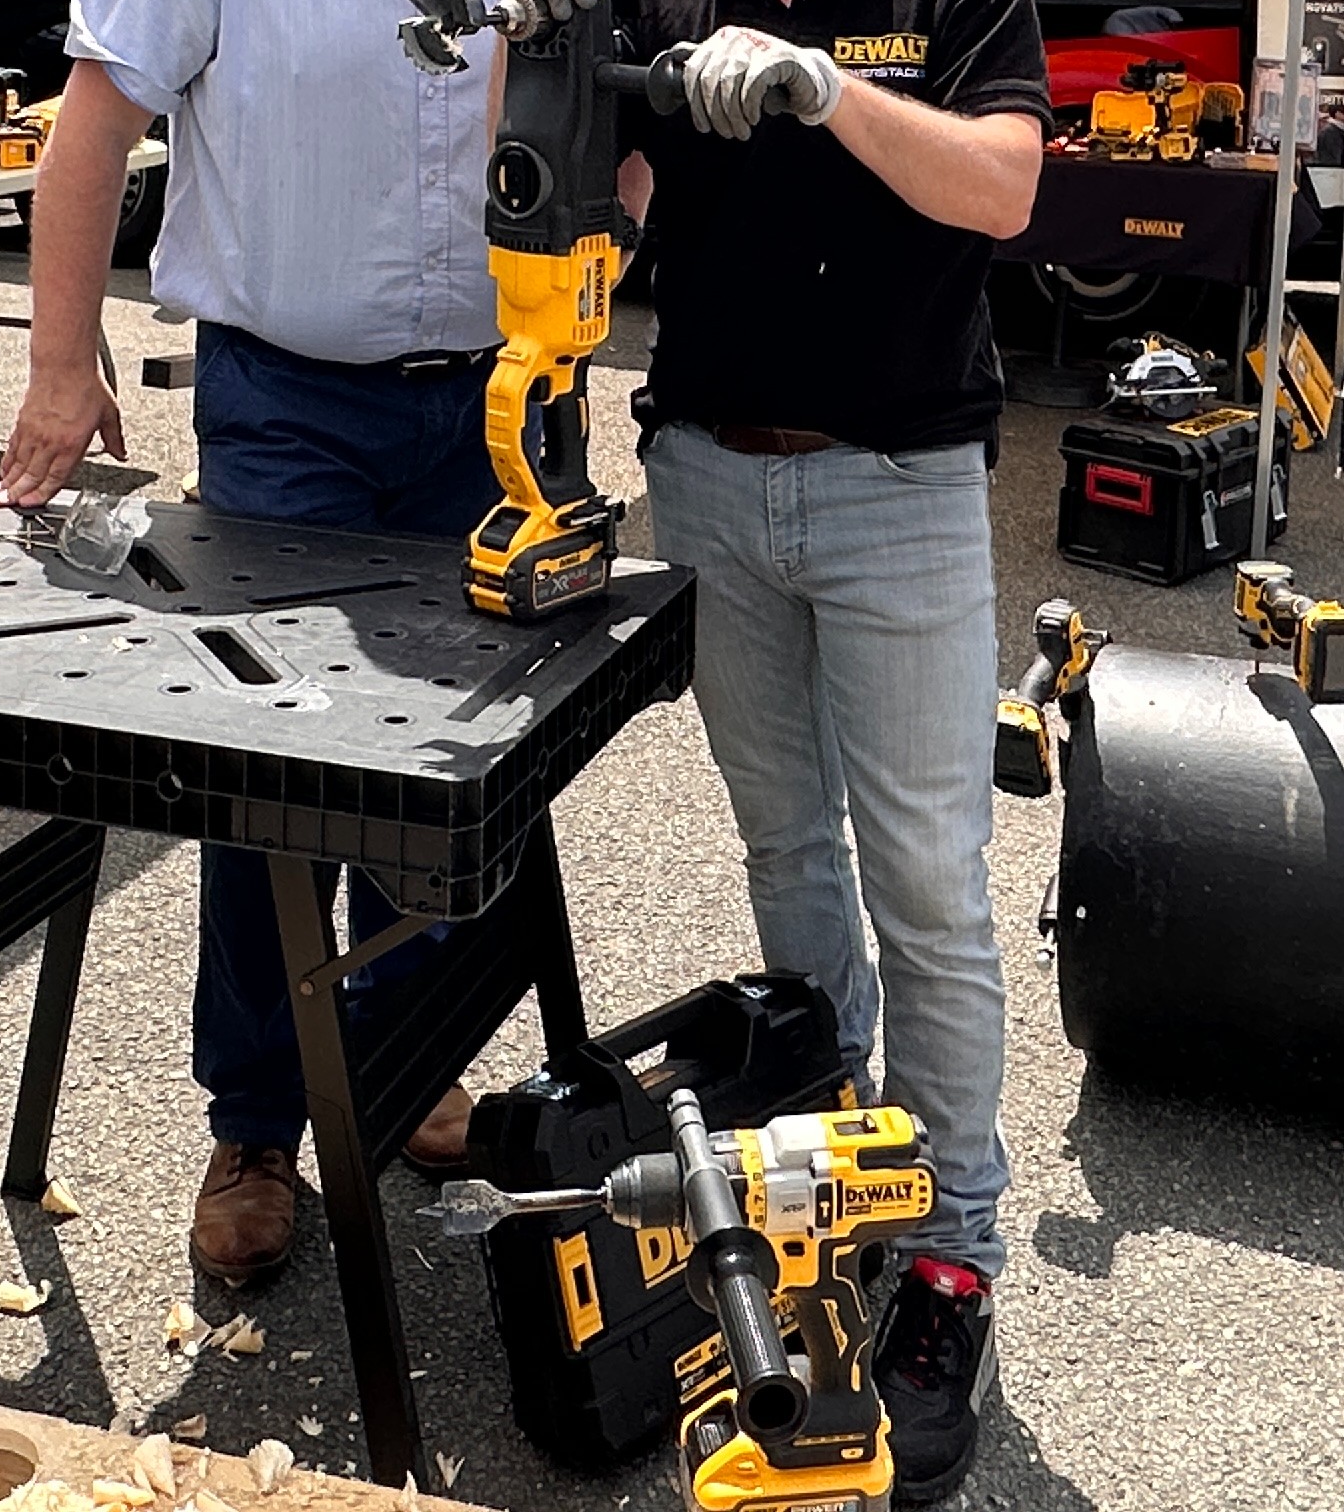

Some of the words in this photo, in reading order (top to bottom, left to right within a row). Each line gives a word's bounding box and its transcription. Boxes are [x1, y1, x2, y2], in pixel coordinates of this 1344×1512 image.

[834, 36, 928, 64] DEWALT
[1125, 218, 1185, 238] DEWALT
[845, 1181, 914, 1204] DEWALT
